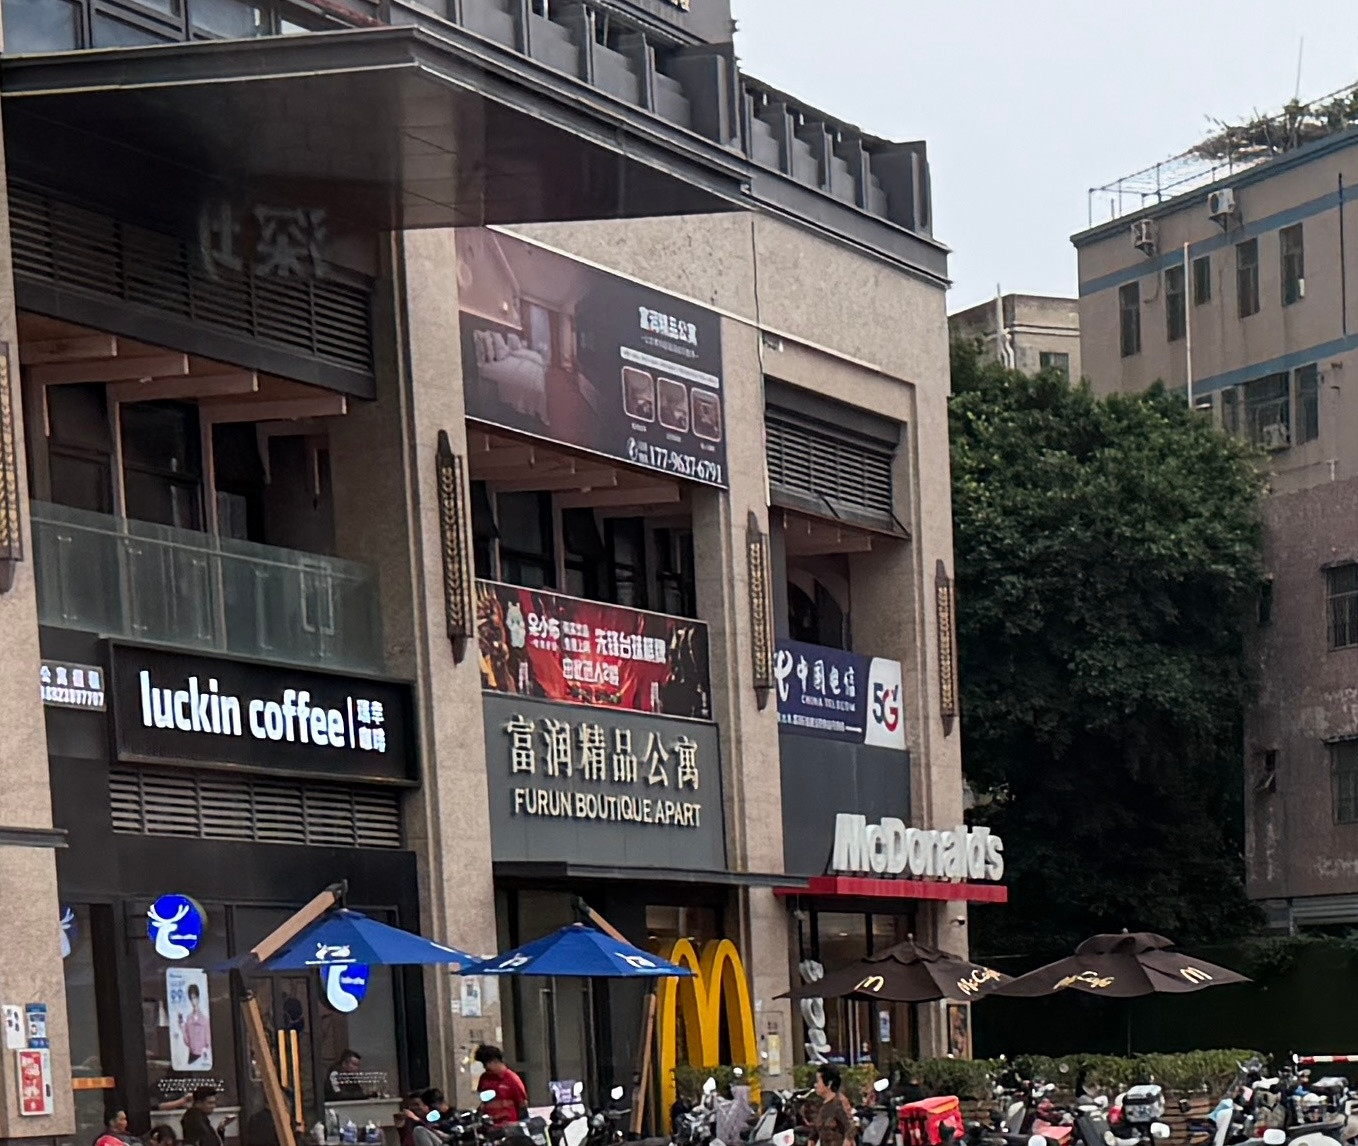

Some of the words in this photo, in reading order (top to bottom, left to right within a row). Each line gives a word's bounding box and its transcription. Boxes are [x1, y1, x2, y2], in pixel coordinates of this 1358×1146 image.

[140, 671, 242, 738] luckin
[249, 688, 346, 749] coffee
[873, 682, 899, 732] 5G
[507, 715, 700, 791] 富润精品公寓
[514, 787, 574, 818] FURUN
[575, 793, 653, 825] BOUTIQUE
[654, 801, 702, 828] APART
